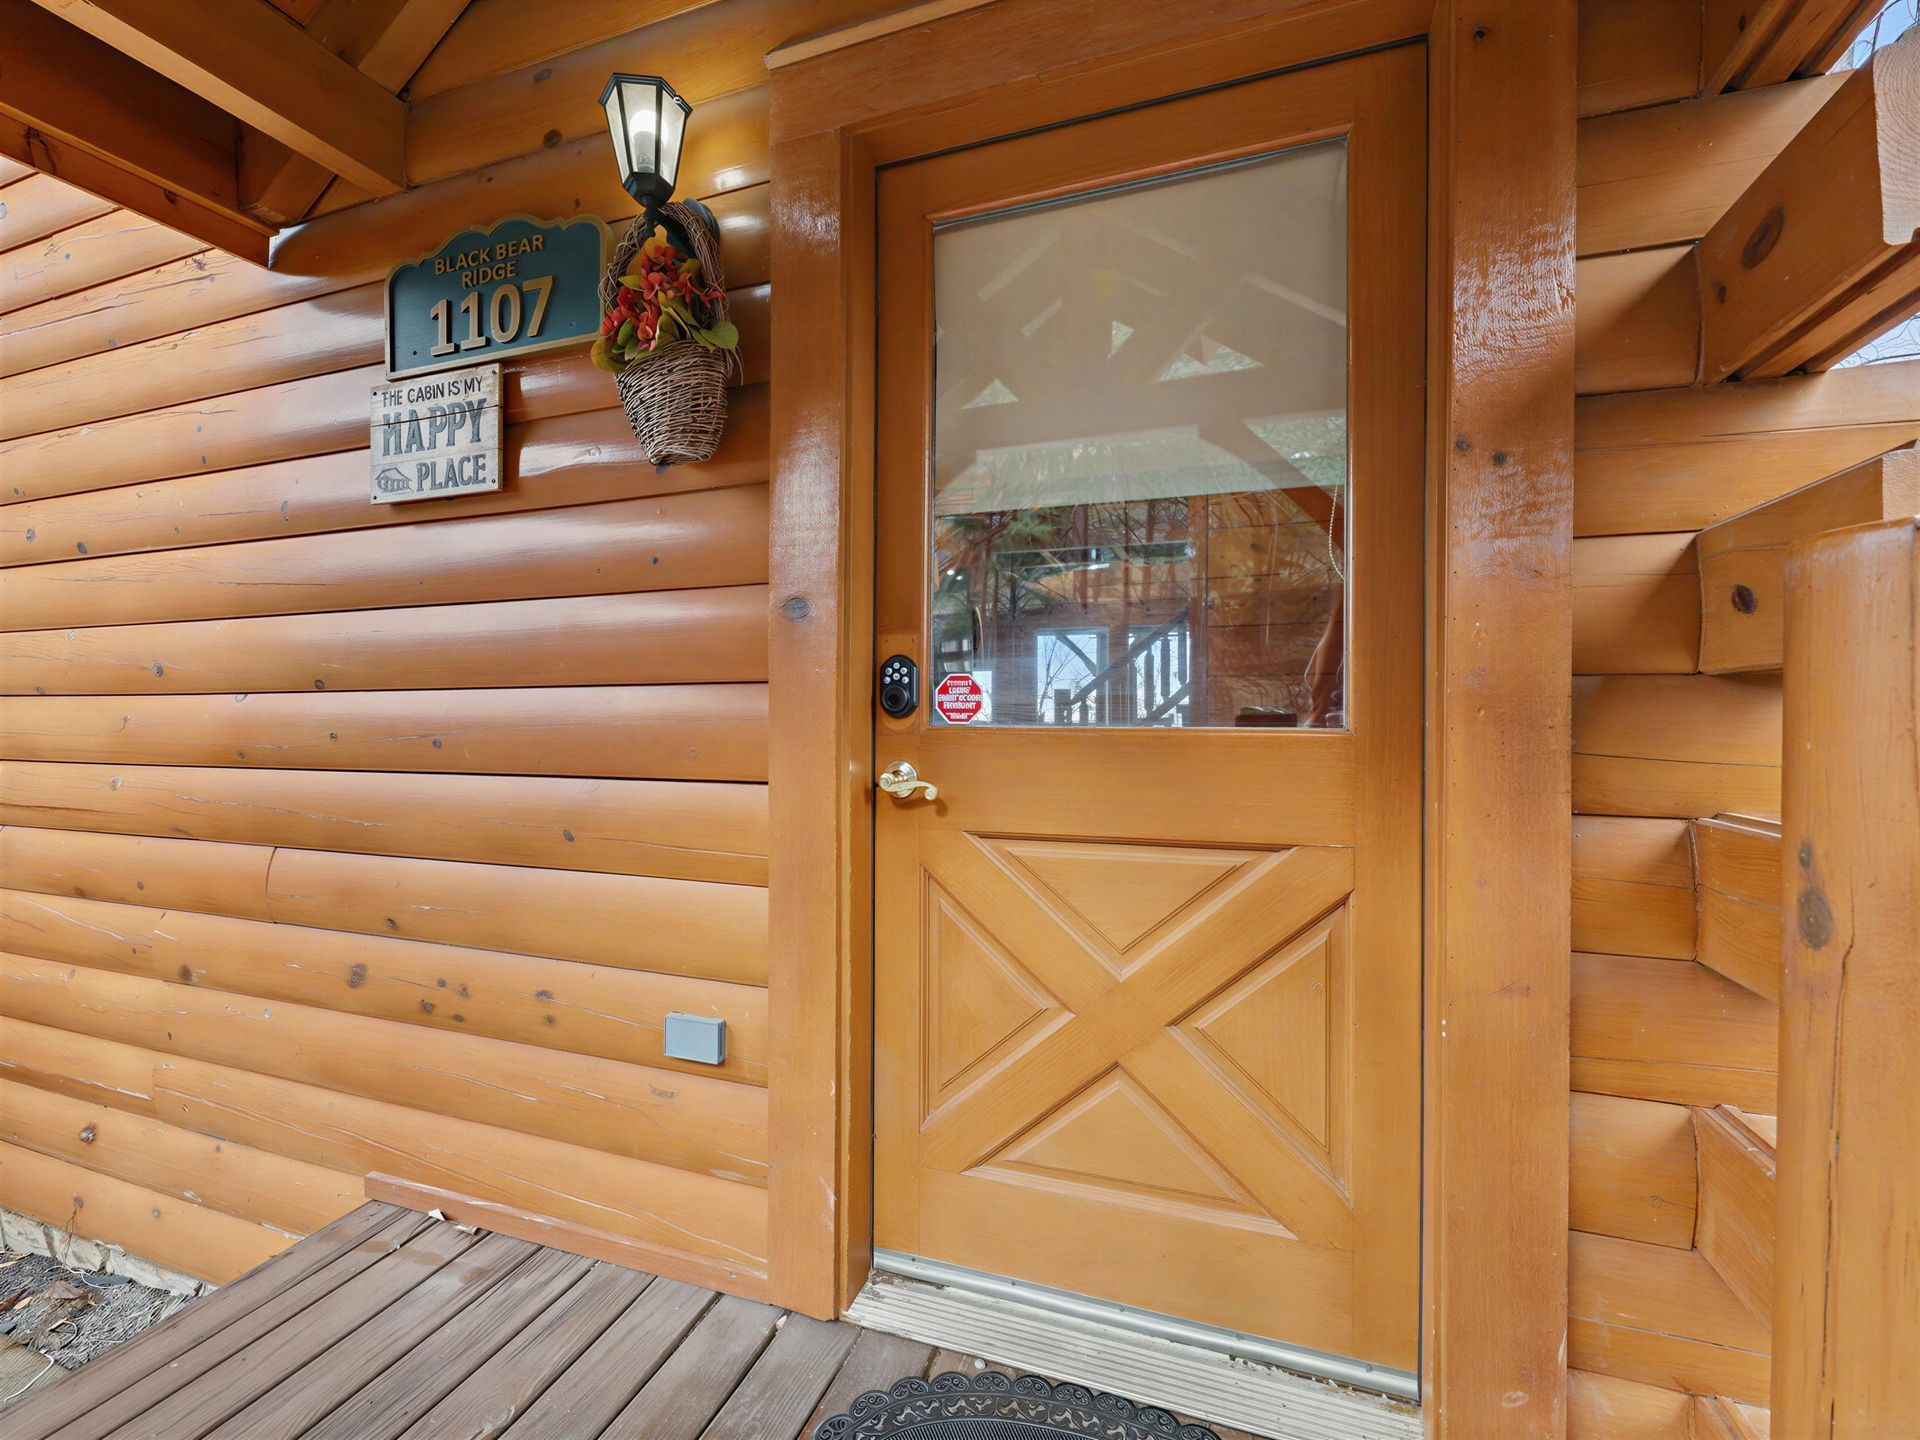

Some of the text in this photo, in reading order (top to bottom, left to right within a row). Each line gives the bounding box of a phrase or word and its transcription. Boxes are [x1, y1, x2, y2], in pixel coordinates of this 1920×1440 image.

[434, 234, 545, 276] BLACK BEAR
[461, 260, 518, 288] RIDGE
[430, 275, 554, 357] 1107
[381, 376, 483, 408] THE CABIN IS MY
[382, 397, 487, 457] HAPPY
[416, 453, 487, 492] PLACE
